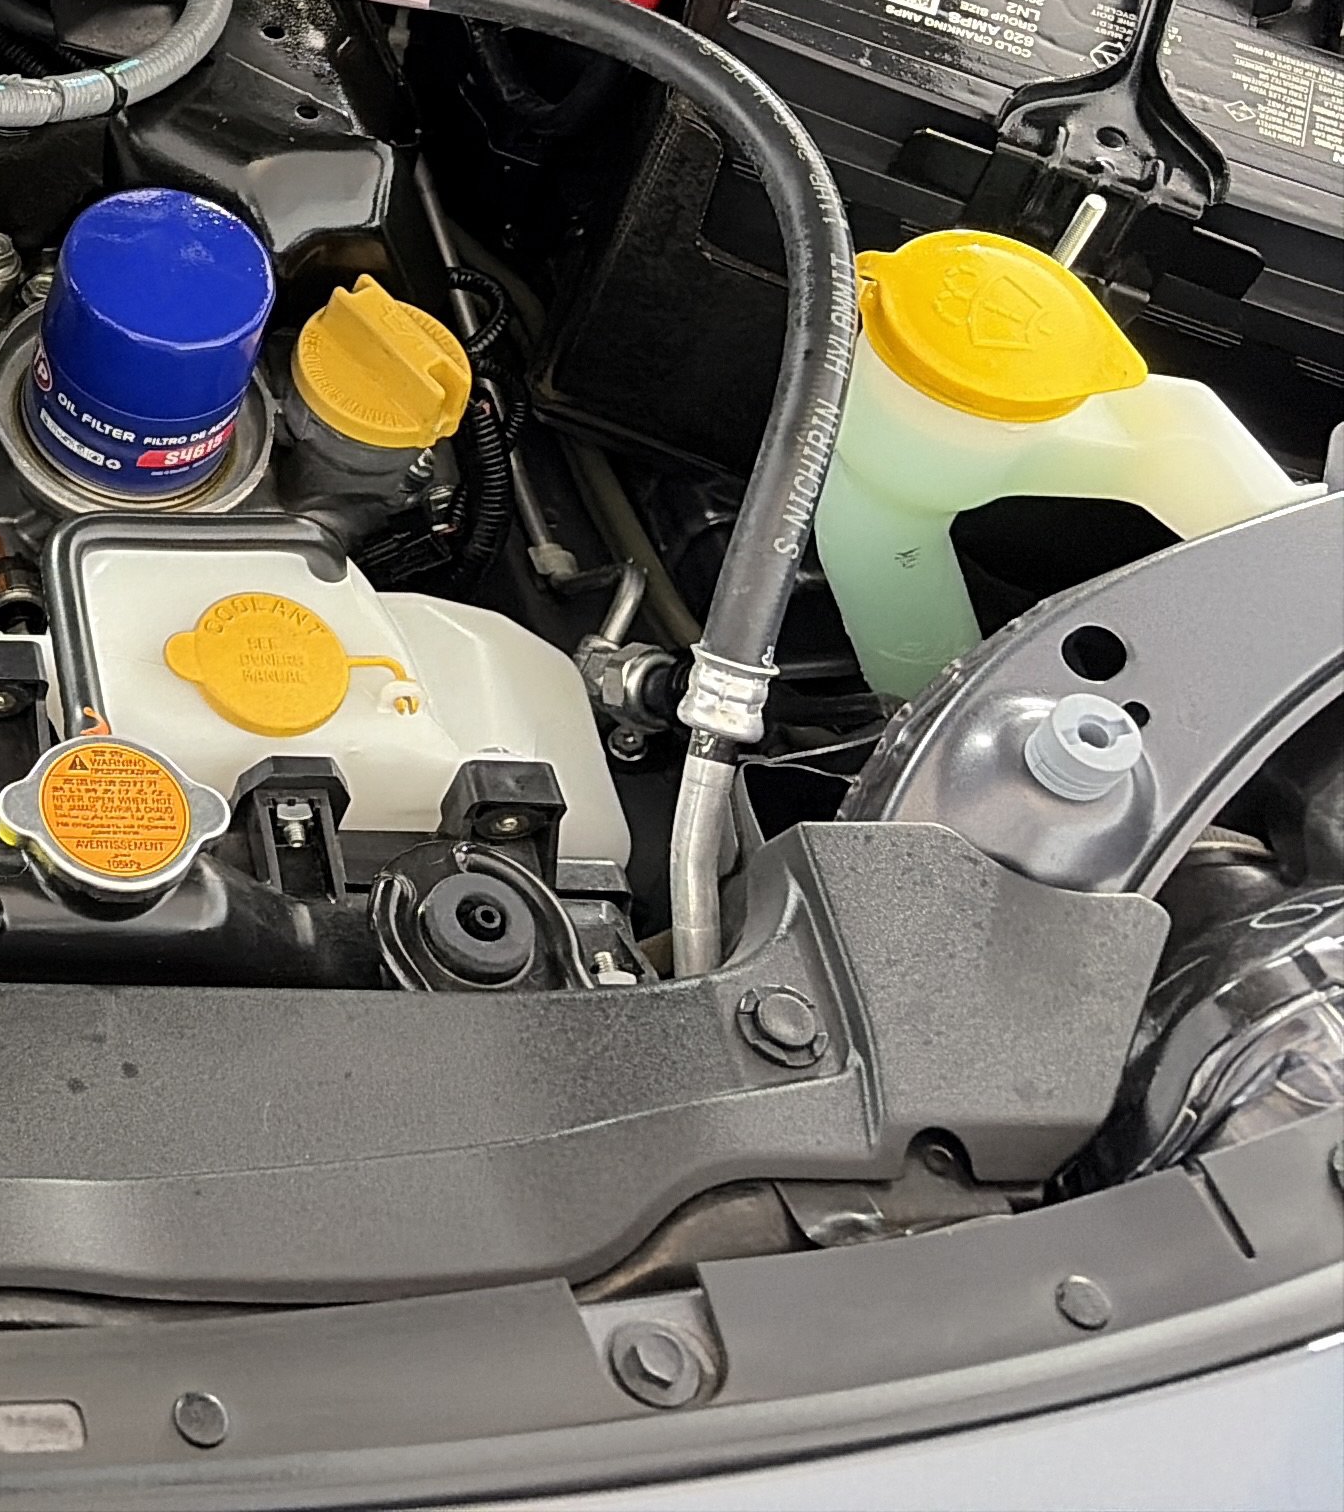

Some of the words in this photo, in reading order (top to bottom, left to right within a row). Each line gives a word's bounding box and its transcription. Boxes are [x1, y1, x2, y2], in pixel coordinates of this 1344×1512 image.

[886, 5, 924, 23] AMPS
[958, 0, 989, 16] SIZE
[1004, 1, 1041, 21] LN2
[946, 10, 1001, 36] AMPS
[989, 10, 1038, 32] GROUP
[923, 16, 993, 45] CRANKING
[993, 39, 1032, 58] COLD
[57, 392, 78, 417] OIL
[81, 413, 136, 443] FILTER
[343, 399, 403, 428] MANUAL
[143, 436, 188, 446] FILTRO
[203, 596, 326, 635] COOLANT
[247, 637, 276, 651] SEE
[241, 669, 307, 684] MANUAL
[90, 758, 146, 768] WARNING
[88, 795, 114, 804] OPEN
[75, 839, 164, 852] AVERTISSEMENT
